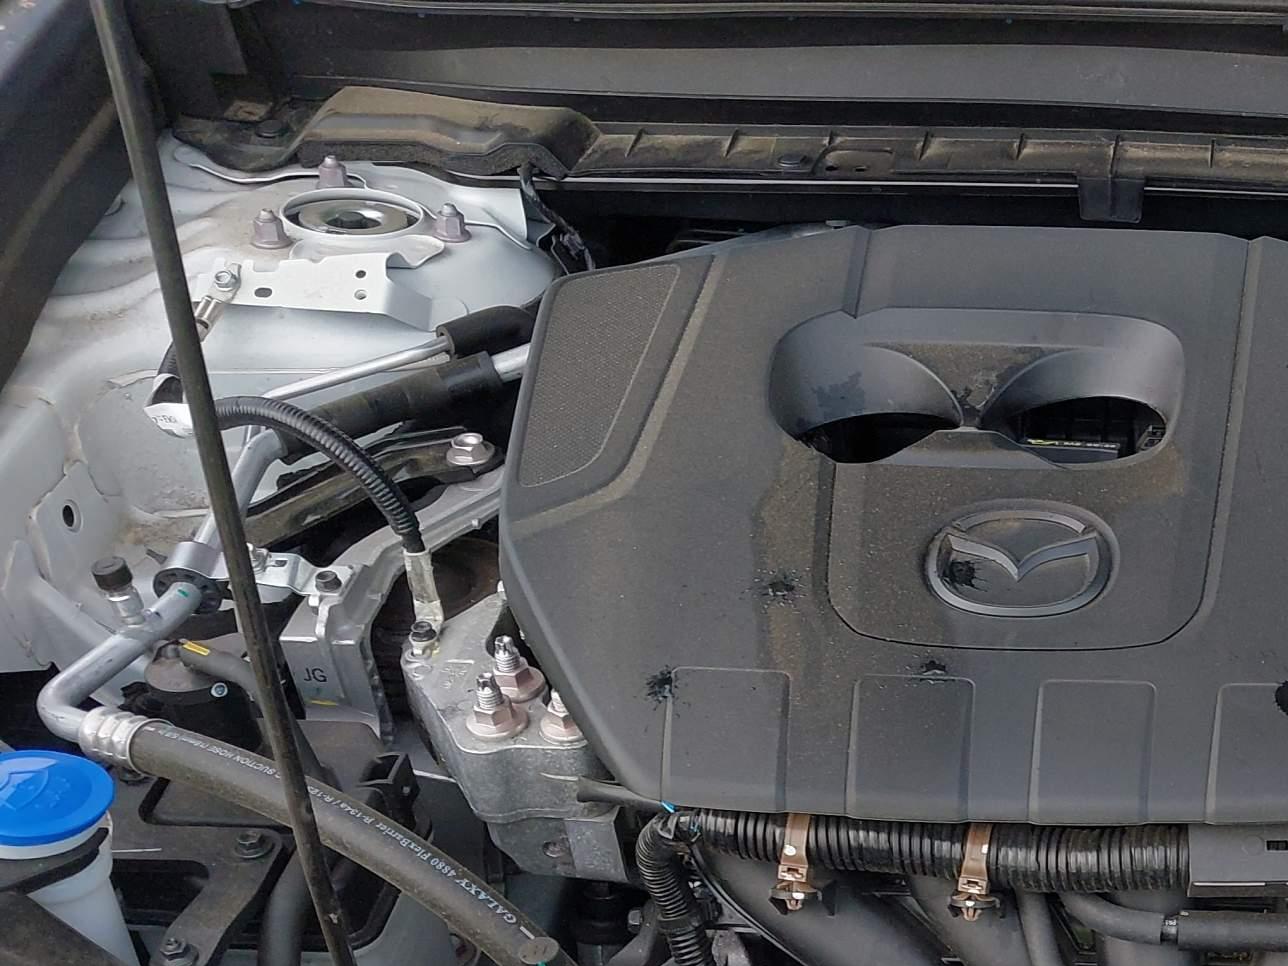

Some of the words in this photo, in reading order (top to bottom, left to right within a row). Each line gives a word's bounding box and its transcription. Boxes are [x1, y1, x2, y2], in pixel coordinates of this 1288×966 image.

[303, 667, 327, 682] JG
[206, 745, 233, 760] HOSE
[233, 754, 278, 776] SUCTION
[340, 802, 375, 825] R-134a
[375, 822, 432, 860] FlexBarrier
[430, 857, 457, 877] 4880
[455, 877, 517, 924] GALAXY
